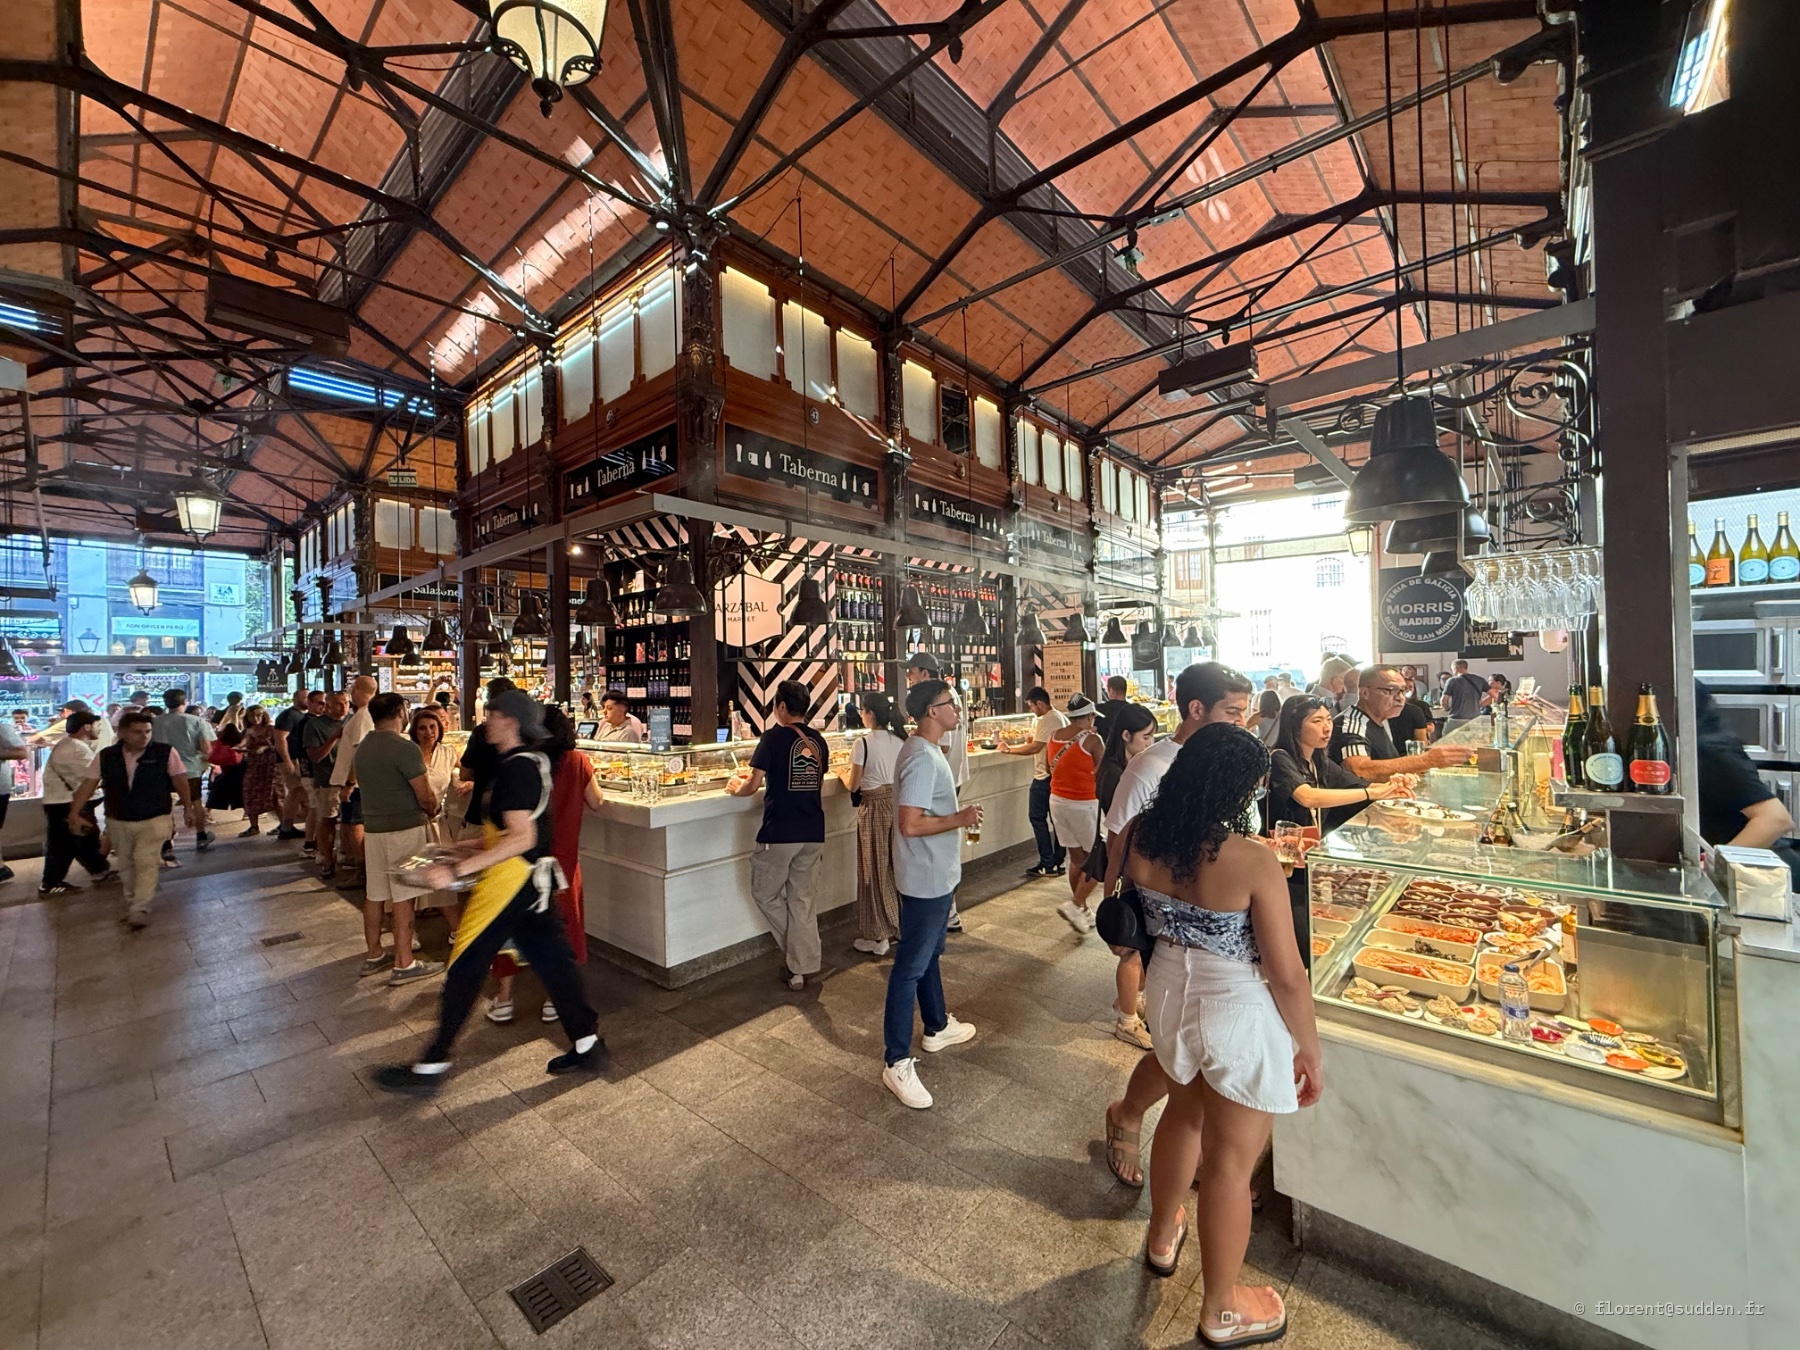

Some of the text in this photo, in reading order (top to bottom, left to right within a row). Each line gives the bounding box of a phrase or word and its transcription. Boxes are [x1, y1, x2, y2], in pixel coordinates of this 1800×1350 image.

[597, 461, 636, 487] Taberna
[780, 453, 838, 487] Taberna
[389, 476, 417, 484] SALIDA
[493, 511, 519, 530] Taberna
[939, 500, 976, 524] Taberna
[1042, 530, 1067, 549] Taberna
[413, 584, 460, 598] Salazone
[1386, 578, 1457, 603] FERIA DE GALICIA
[1387, 601, 1455, 615] MORRIS
[1384, 612, 1459, 641] MERCADO SAN MIGUEL
[1399, 617, 1442, 627] MADRID
[1472, 638, 1508, 646] TENAZAS
